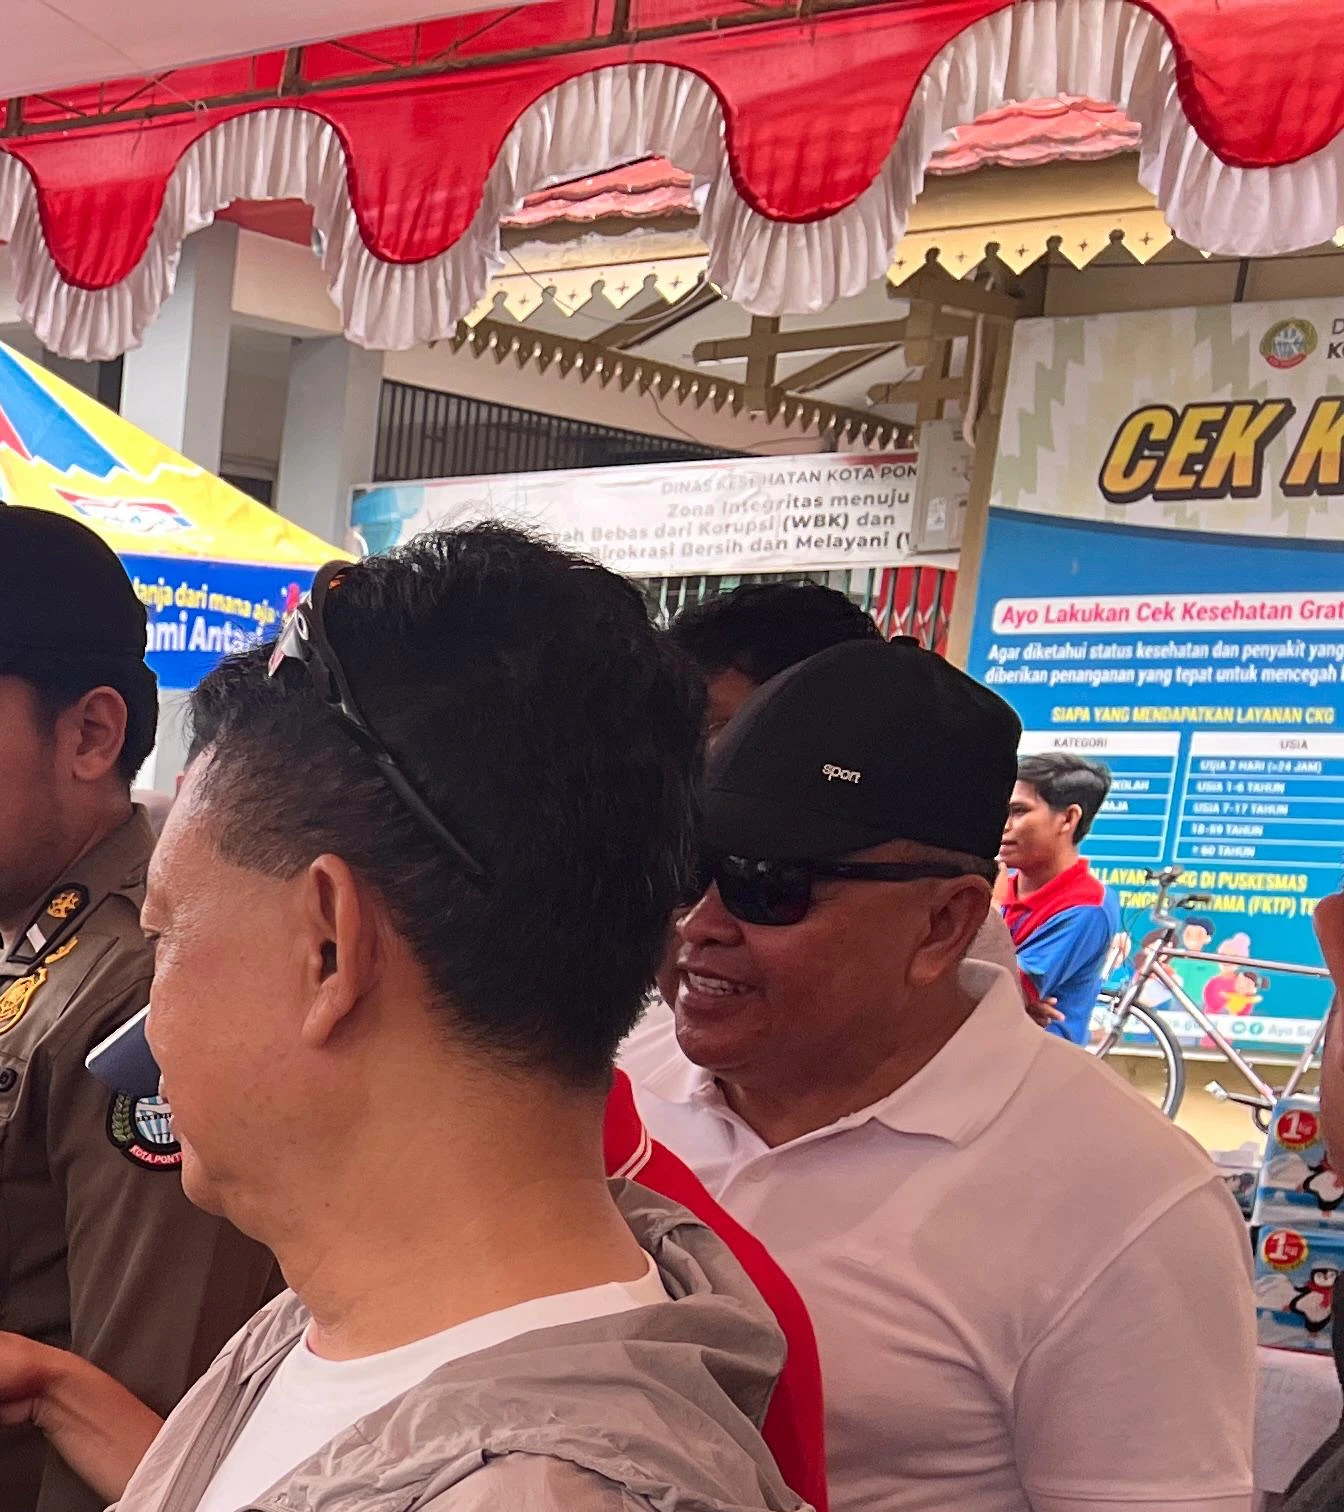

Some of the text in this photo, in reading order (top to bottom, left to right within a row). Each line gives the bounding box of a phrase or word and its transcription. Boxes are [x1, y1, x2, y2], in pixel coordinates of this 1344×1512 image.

[1101, 398, 1294, 502] CEK
[827, 467, 874, 482] KOTA
[667, 489, 910, 518] Zona Integritas menuju
[591, 525, 648, 541] Bebas
[654, 523, 691, 539] dari
[698, 519, 774, 538] Korupsi
[783, 513, 849, 532] (WBK)
[857, 511, 895, 526] dan
[682, 538, 742, 556] Bersih
[750, 536, 788, 552] dan
[796, 532, 889, 550] Melayani
[175, 582, 208, 608] dari
[209, 592, 252, 617] mana
[1001, 605, 1038, 628] Ayo
[1045, 603, 1129, 624] Lakukan
[1136, 602, 1176, 622] Cek
[1181, 600, 1292, 621] Kesehatan
[988, 644, 1019, 664] Agar
[1023, 641, 1088, 660] diketahui
[1090, 642, 1133, 660] status
[1136, 640, 1209, 659] kesehatan
[1213, 640, 1239, 659] dan
[1243, 639, 1306, 662] penyakit
[985, 664, 1337, 688] diberikan penanganan yang tepat untuk mencegah
[1052, 706, 1090, 722] SIAPA
[1094, 706, 1130, 722] YANG
[1133, 706, 1234, 723] MENDAPATKAN
[1237, 706, 1303, 724] LAYANAN
[1054, 737, 1108, 748] KATEGORI
[1281, 738, 1308, 750] USIA
[1200, 871, 1216, 888] DI
[1218, 871, 1309, 892] PUSKESMAS
[1282, 1111, 1302, 1139] 1
[1269, 1231, 1288, 1261] 1
